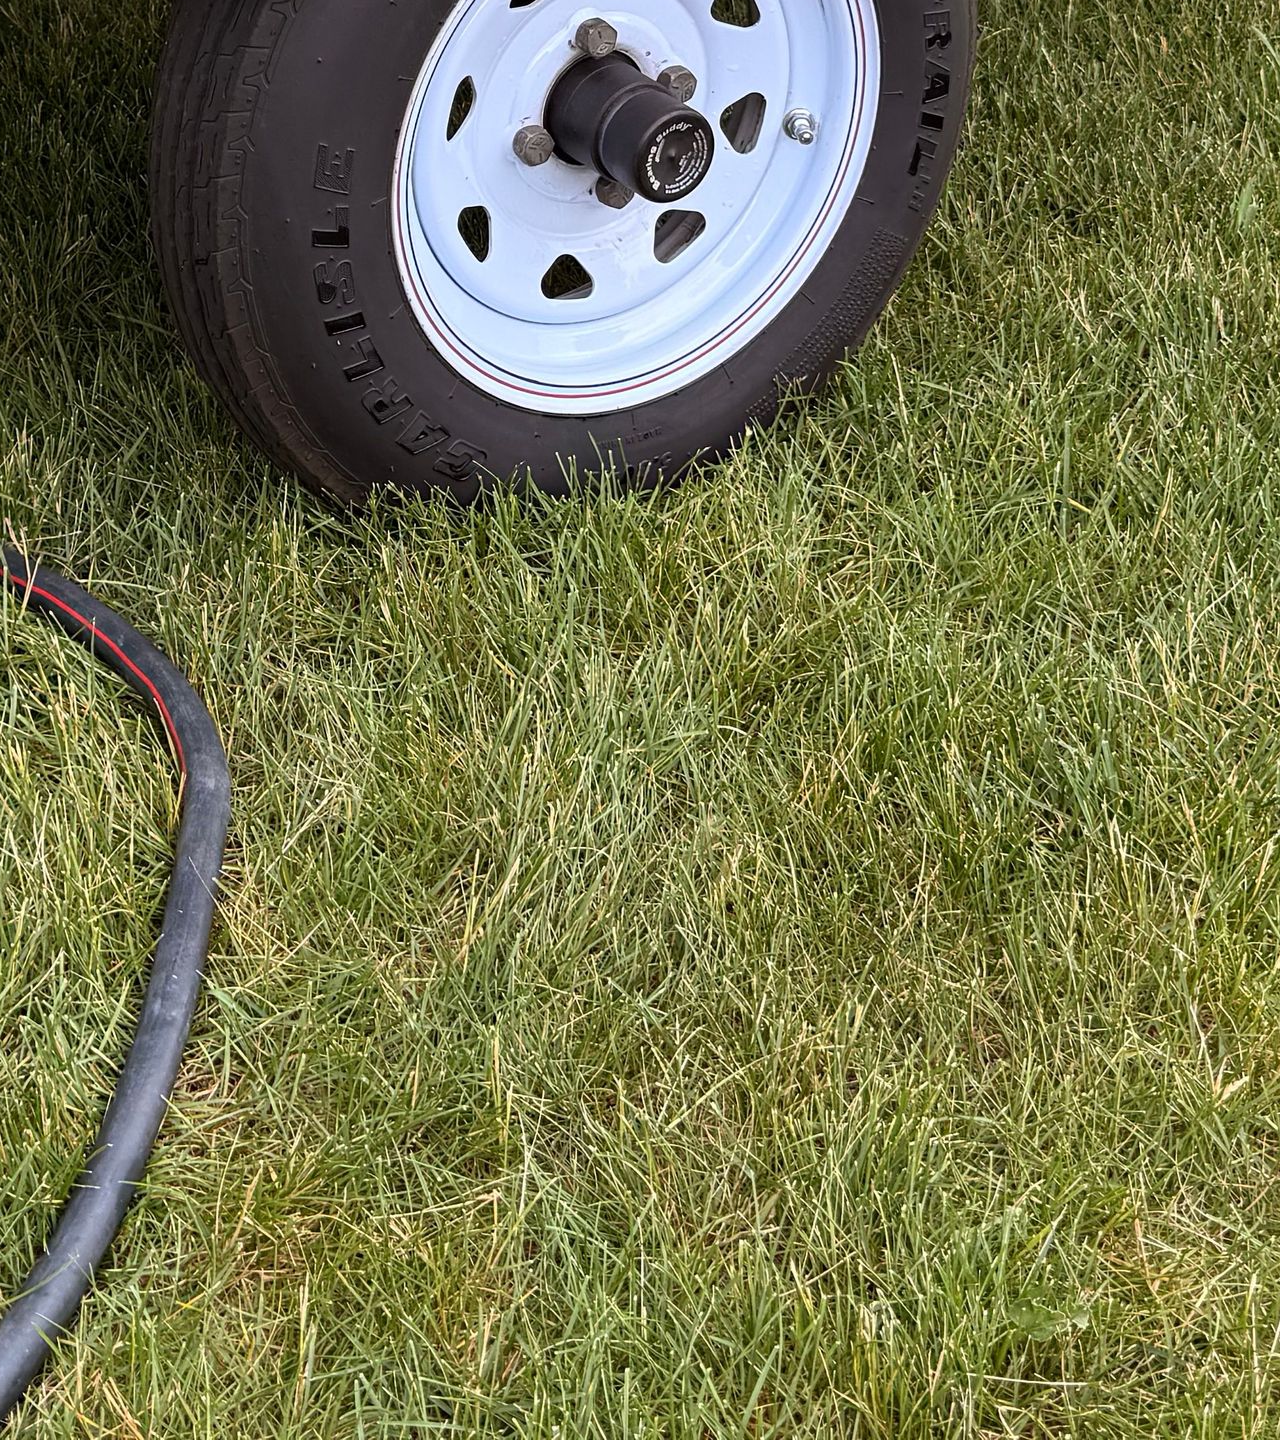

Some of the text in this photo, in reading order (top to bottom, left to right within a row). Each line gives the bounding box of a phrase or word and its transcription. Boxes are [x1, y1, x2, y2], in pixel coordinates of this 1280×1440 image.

[645, 145, 661, 191] Bearing
[655, 121, 693, 143] Buddy
[312, 142, 488, 482] CARLISLE
